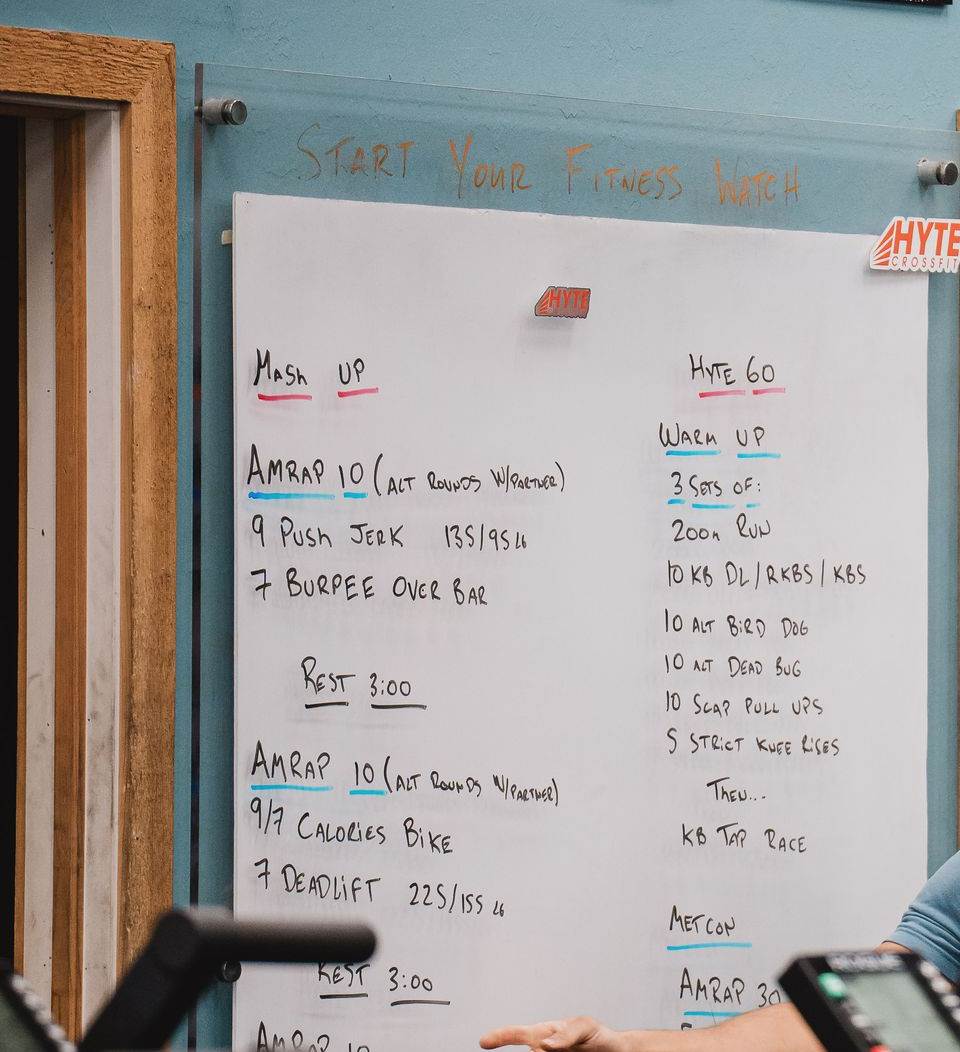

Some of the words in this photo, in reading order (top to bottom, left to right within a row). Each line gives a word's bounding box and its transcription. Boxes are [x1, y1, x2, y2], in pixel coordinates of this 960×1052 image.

[296, 123, 414, 180] START
[449, 130, 533, 199] YOUR
[565, 144, 684, 200] FITNESS
[714, 156, 800, 207] WATCH
[891, 256, 958, 269] CROSSFIT
[549, 288, 589, 310] HYTE
[338, 358, 366, 385] UP
[689, 353, 736, 386] HYTE
[746, 355, 775, 384] 60
[659, 422, 717, 447] WARM
[736, 426, 765, 447] UP
[247, 443, 325, 486] AMRAP
[339, 462, 364, 486] 10
[427, 471, 481, 493] ROUNDS
[671, 471, 683, 496] 3
[689, 474, 723, 498] SETS
[733, 477, 761, 495] OF:
[252, 514, 266, 548] 9
[350, 523, 404, 548] JERK
[444, 524, 510, 551] 135/95
[736, 512, 771, 539] RUN
[250, 569, 272, 601] 7
[286, 567, 375, 601] BURPEE
[392, 576, 441, 601] OVER
[453, 577, 488, 606] BAR
[667, 559, 684, 587] 10
[691, 564, 713, 588] KB
[664, 608, 683, 633] 10
[692, 616, 715, 634] ALT
[781, 617, 809, 638] DOG
[301, 656, 356, 695] REST
[369, 672, 412, 698] 3:00
[664, 652, 684, 674] 10
[693, 658, 714, 673] ALT
[727, 655, 763, 678] DEAD
[776, 656, 802, 678] BUG
[666, 690, 681, 712] 10
[693, 693, 731, 718] SCAP
[744, 696, 780, 716] PULL
[792, 696, 824, 715] UPS
[756, 737, 792, 756] KNEE
[251, 739, 331, 781] AMRAP
[354, 761, 375, 786] 10
[430, 770, 482, 797] ROUNDS
[250, 796, 285, 835] 9/7
[682, 823, 707, 848] KB
[764, 828, 807, 854] RACE
[254, 858, 271, 890] 7
[408, 882, 484, 914] 225/155
[669, 904, 736, 936] METCON
[317, 961, 371, 987] REST
[389, 966, 434, 992] 3:00
[679, 967, 745, 1004] AMRAP
[757, 983, 781, 1009] 30
